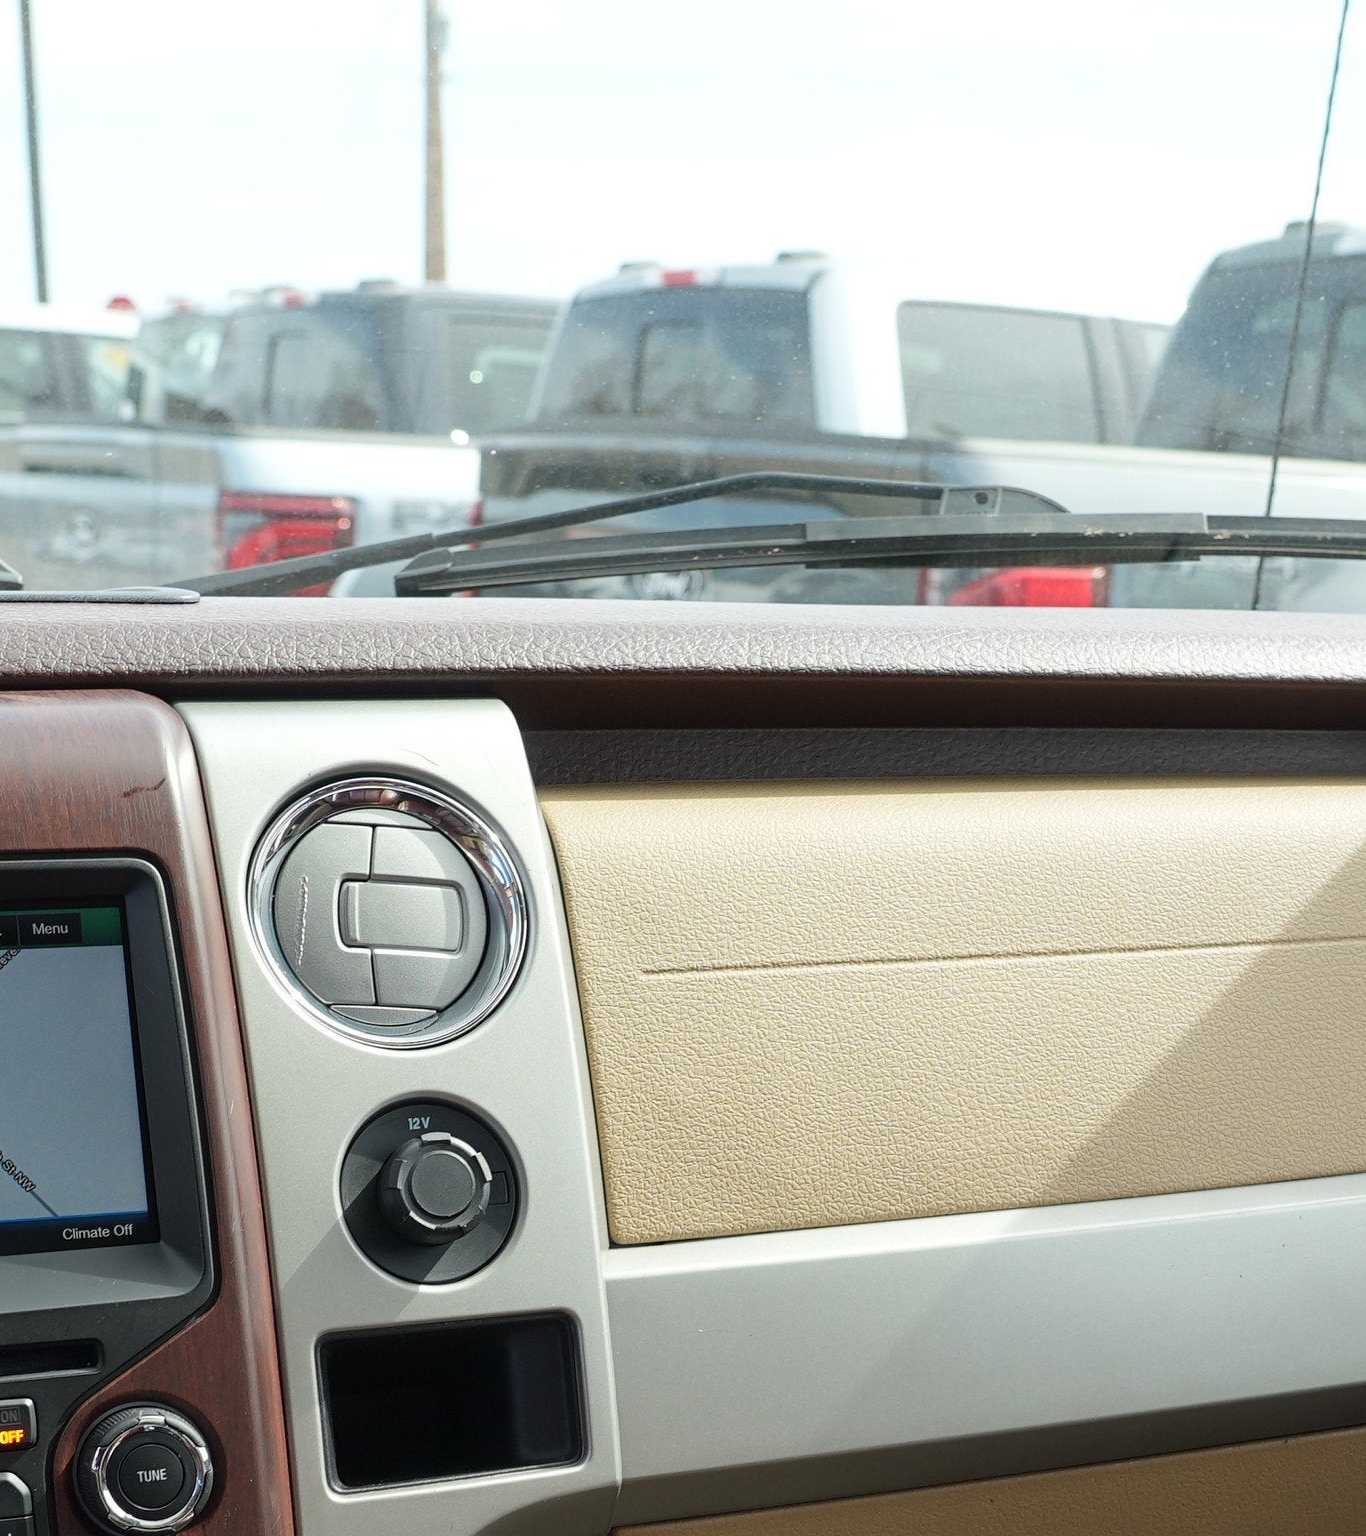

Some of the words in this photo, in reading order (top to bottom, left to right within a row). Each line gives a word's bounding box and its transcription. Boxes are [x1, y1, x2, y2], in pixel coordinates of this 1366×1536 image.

[32, 923, 69, 935] Menu
[408, 1116, 431, 1131] 12V
[2, 1157, 18, 1176] St
[13, 1170, 36, 1193] NW
[62, 1226, 110, 1241] Climate
[113, 1224, 134, 1238] Off
[1, 1410, 18, 1423] ON
[136, 1468, 168, 1483] TUNE
